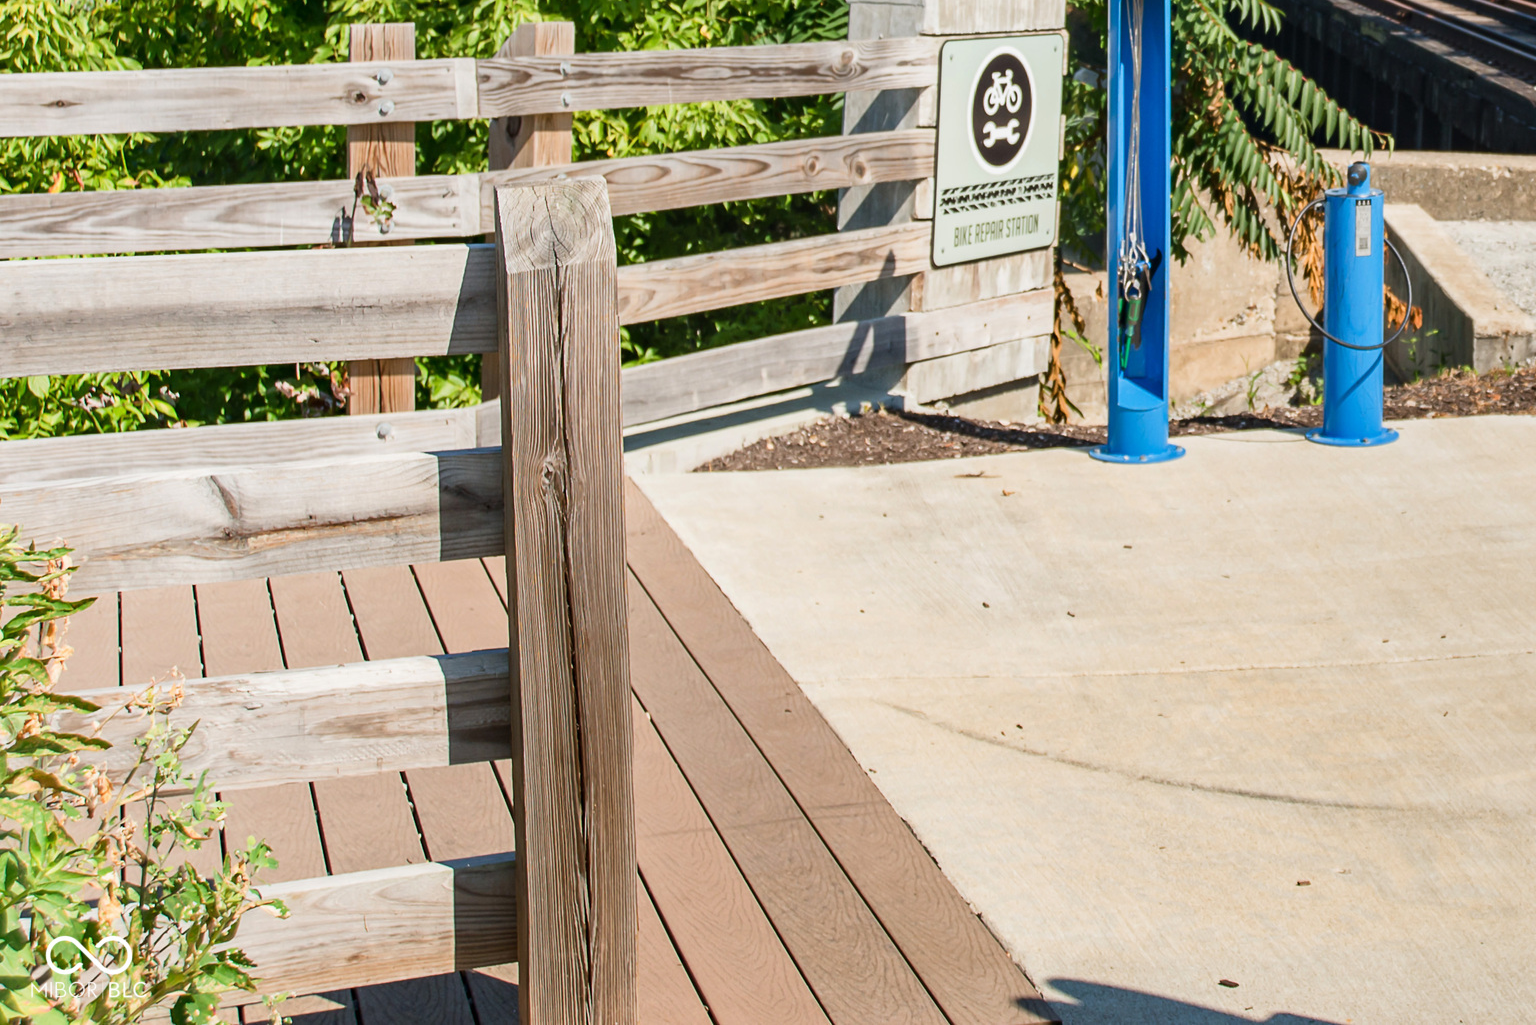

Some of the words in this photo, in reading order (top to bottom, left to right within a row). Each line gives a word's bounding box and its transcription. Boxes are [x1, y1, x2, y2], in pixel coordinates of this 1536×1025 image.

[954, 224, 973, 248] BIKE
[975, 219, 1004, 244] REPAIR
[1006, 213, 1039, 238] STATION
